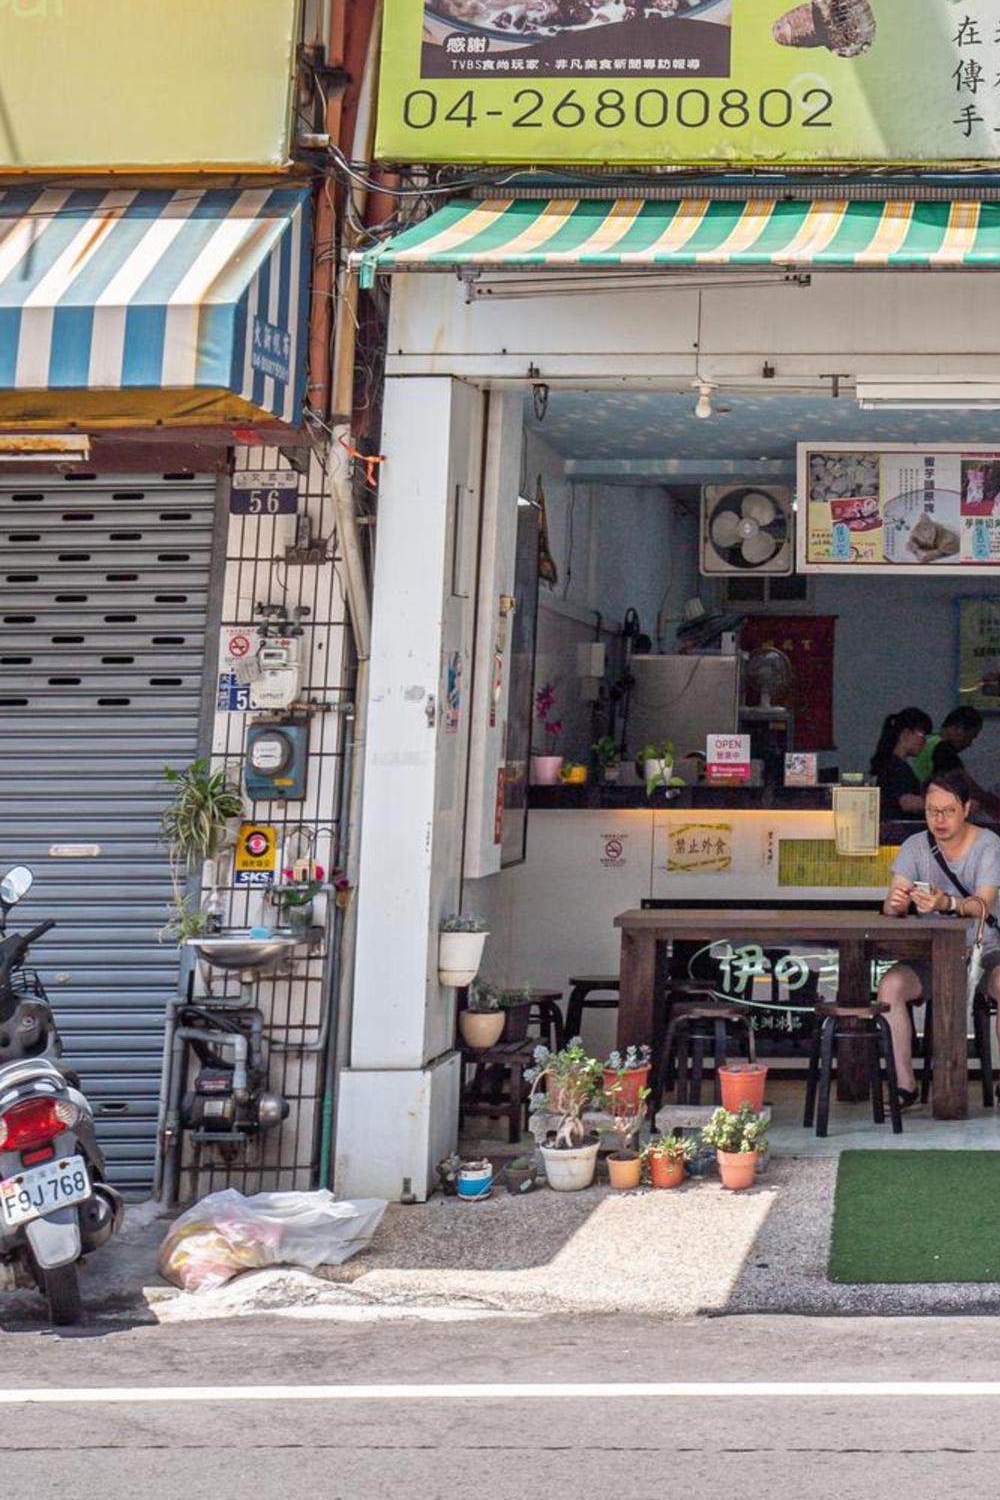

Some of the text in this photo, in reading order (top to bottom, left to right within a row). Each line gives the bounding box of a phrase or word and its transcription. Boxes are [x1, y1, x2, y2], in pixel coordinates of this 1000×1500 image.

[445, 36, 488, 54] 感謝
[402, 88, 834, 130] 04-26800802
[249, 490, 279, 513] 56
[715, 739, 742, 749] OPEN
[674, 838, 727, 855] 禁止外食
[240, 871, 271, 883] SKS
